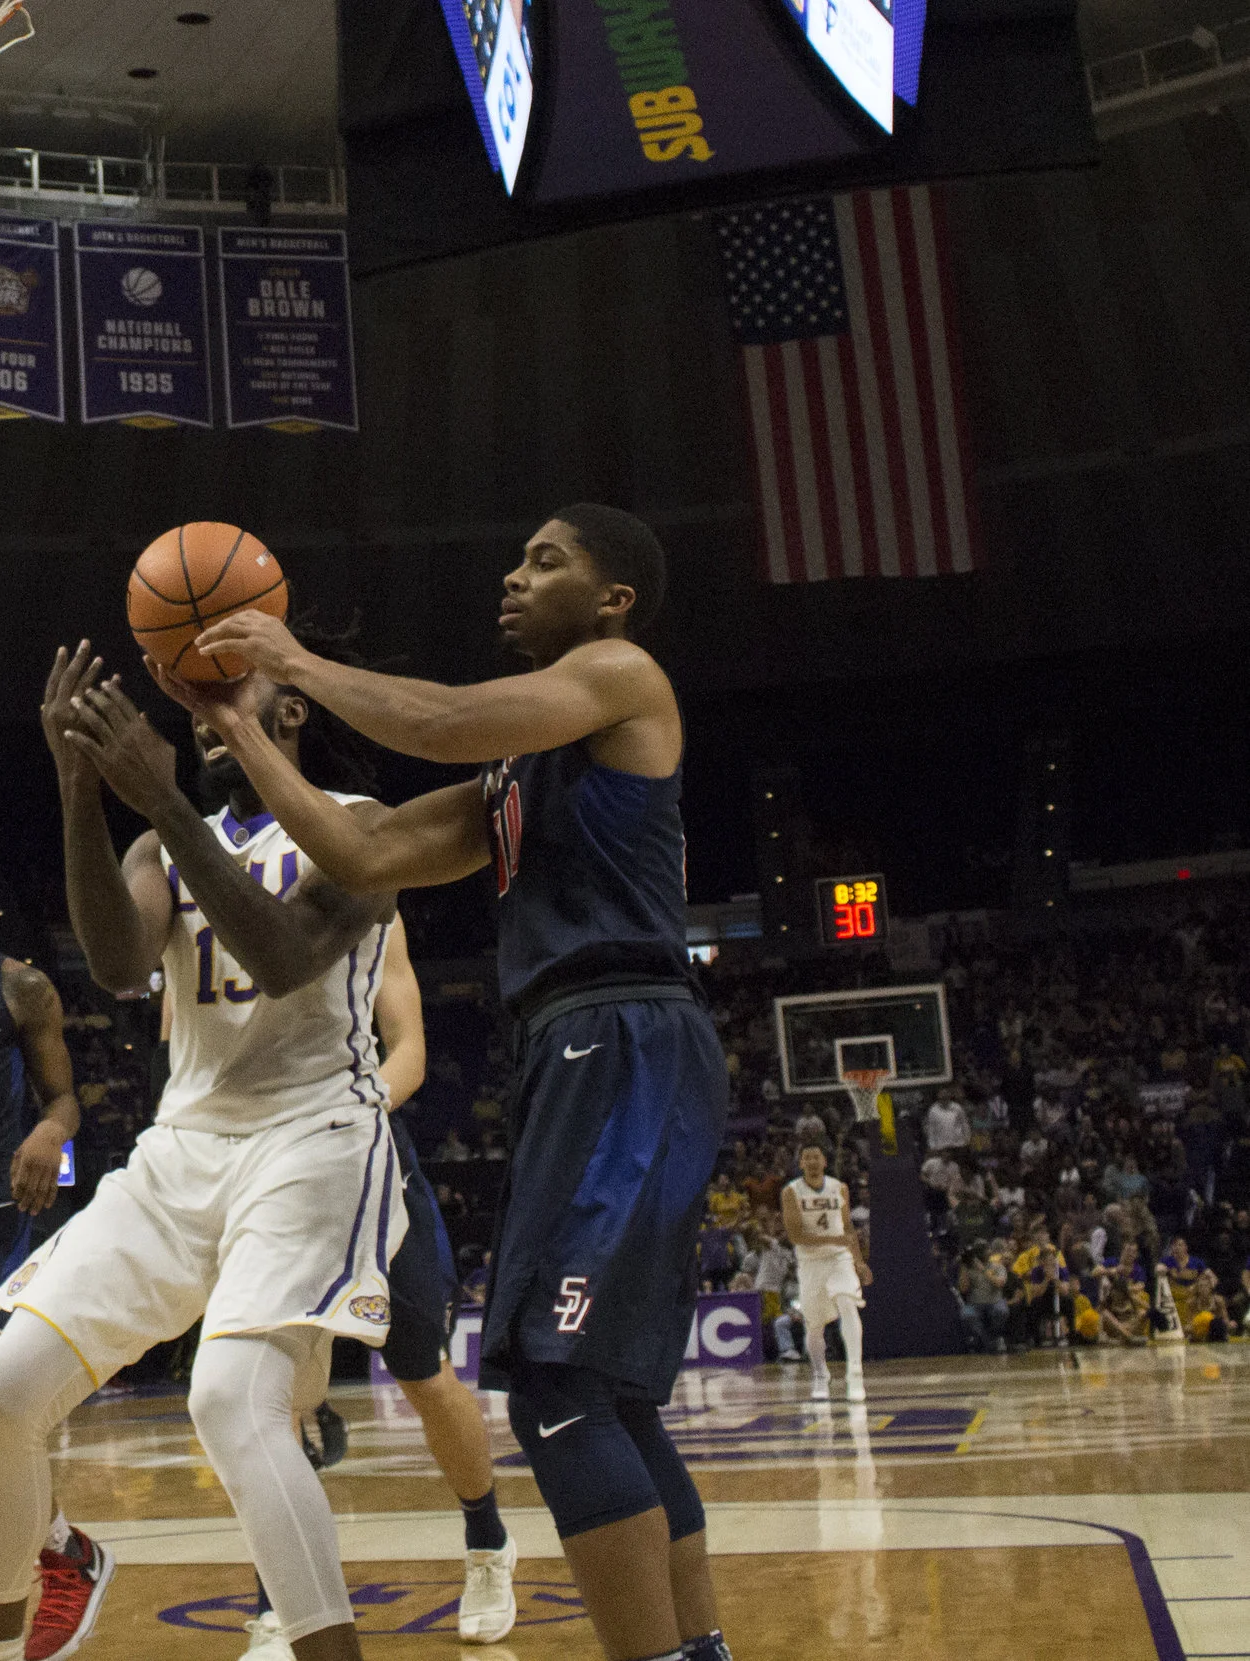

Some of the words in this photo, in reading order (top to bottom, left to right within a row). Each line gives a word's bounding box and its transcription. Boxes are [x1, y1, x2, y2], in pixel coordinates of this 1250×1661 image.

[258, 279, 312, 299] DALE
[246, 298, 327, 319] BROWN
[104, 319, 183, 338] NATIONAL
[96, 335, 194, 354] CHAMPIONS
[0, 351, 38, 368] FOUR
[116, 370, 174, 396] 1935
[833, 902, 876, 938] 30
[801, 1198, 840, 1212] LSU
[816, 1213, 829, 1230] 4
